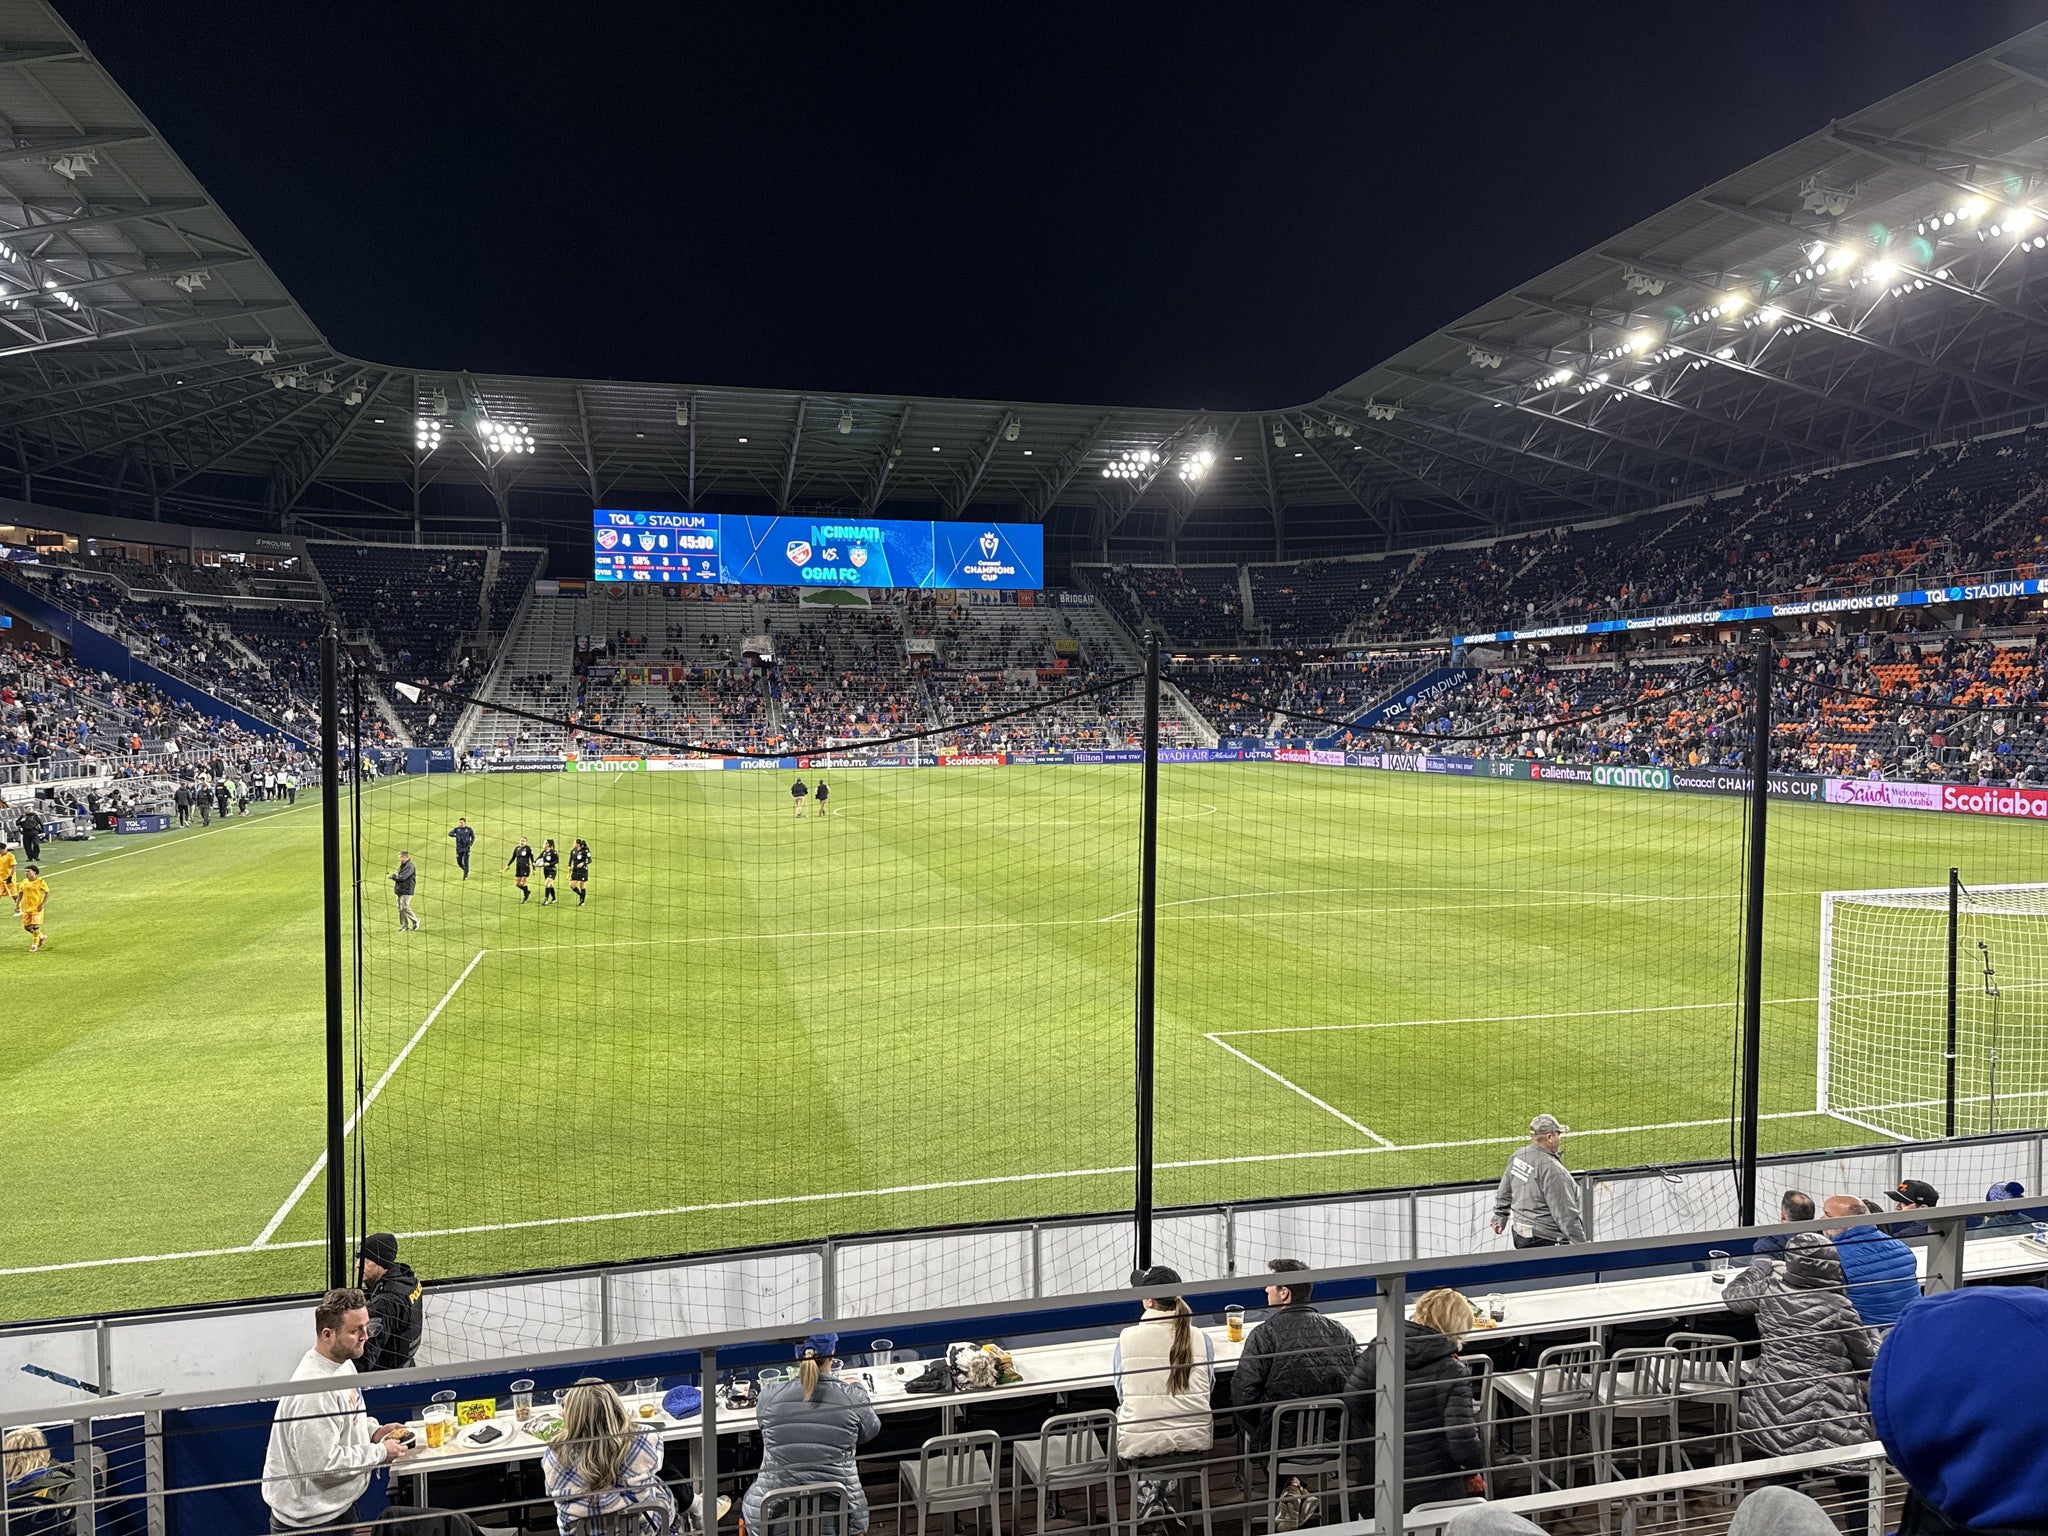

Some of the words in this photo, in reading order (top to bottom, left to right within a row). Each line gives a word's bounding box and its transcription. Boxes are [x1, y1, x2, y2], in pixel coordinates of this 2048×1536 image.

[608, 514, 634, 525] TQL
[649, 516, 705, 527] STADIUM
[622, 534, 631, 547] 4
[658, 534, 668, 548] 0
[679, 536, 714, 549] 45:00
[839, 568, 858, 581] FC
[964, 566, 1015, 575] CHAMPIONS
[981, 574, 998, 582] CUP
[1925, 590, 1950, 603] TQL
[1964, 582, 2024, 600] STADIUM
[1772, 603, 1811, 617] Concacaf
[1812, 597, 1873, 614] CHAMPIONS
[1875, 595, 1898, 608] CUP
[1626, 618, 1656, 630] Concacaf
[1656, 614, 1702, 627] CHAMPIONS
[1703, 612, 1721, 622] CUP
[1537, 626, 1573, 638] CHAMPIONS
[1574, 625, 1589, 634] CUP
[1383, 702, 1408, 719] TQL
[1418, 670, 1468, 701] STADIUM
[945, 756, 1000, 766] Scotiabank
[1076, 754, 1100, 762] Hilton
[1192, 751, 1208, 760] AIR
[576, 760, 639, 772] aramco
[741, 759, 779, 769] molten
[1427, 762, 1444, 770] Hilton
[1499, 763, 1514, 776] PIF
[1541, 766, 1592, 781] caliente.mx
[1594, 767, 1664, 789] aramco
[1673, 774, 1716, 789] Concacaf
[1792, 782, 1818, 796] CUP
[1840, 781, 1891, 804] Saudi
[1892, 787, 1927, 798] Welcome
[1908, 798, 1933, 807] Arabia
